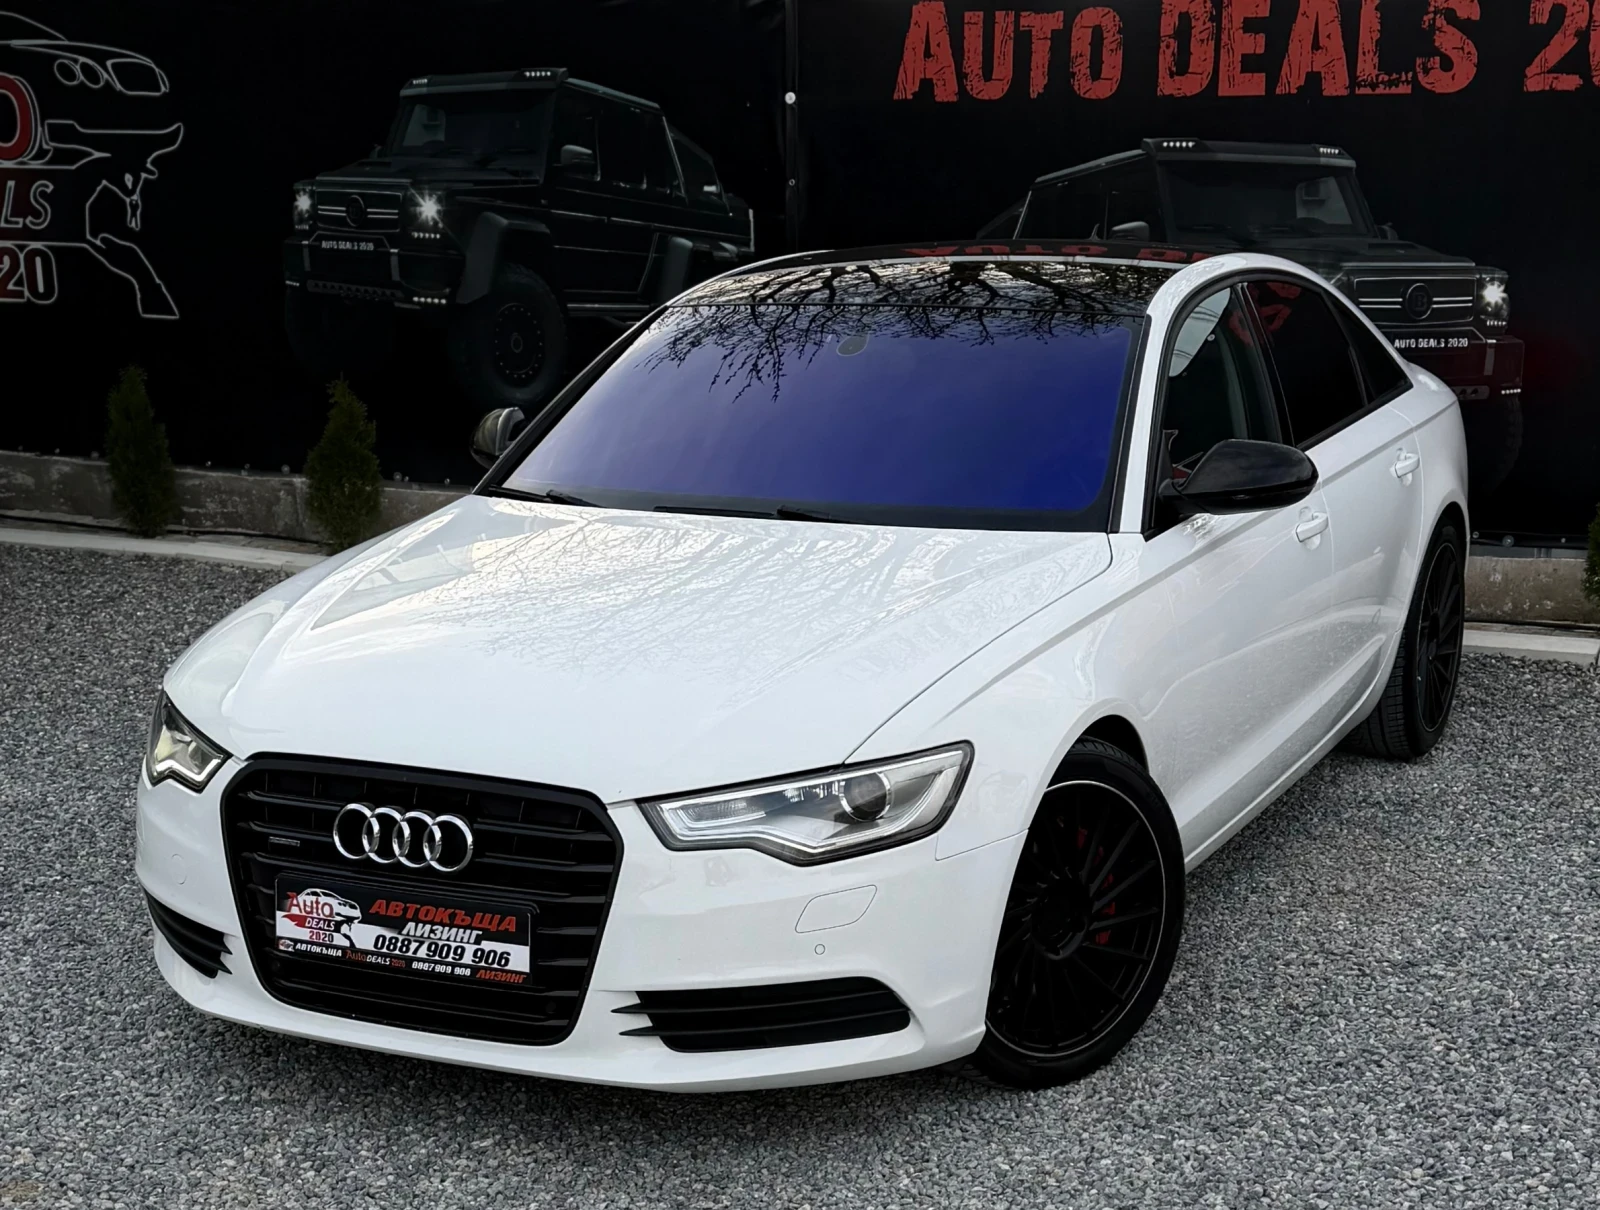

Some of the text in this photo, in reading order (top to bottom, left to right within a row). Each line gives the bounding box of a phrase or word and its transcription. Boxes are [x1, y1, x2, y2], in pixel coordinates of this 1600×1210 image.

[893, 0, 1600, 102] AUTO DEALS 2
[1394, 338, 1469, 349] AUTO DEALS 2020
[286, 892, 335, 919] Auto
[369, 899, 517, 932] АВТОКЪЩА
[305, 918, 335, 931] DEALS
[402, 922, 483, 944] ЛИЗИНГ
[308, 930, 334, 943] 2020
[295, 942, 343, 957] АВТОКЪЩА
[476, 969, 527, 983] ЛИЗИНГ
[471, 948, 511, 968] 906
